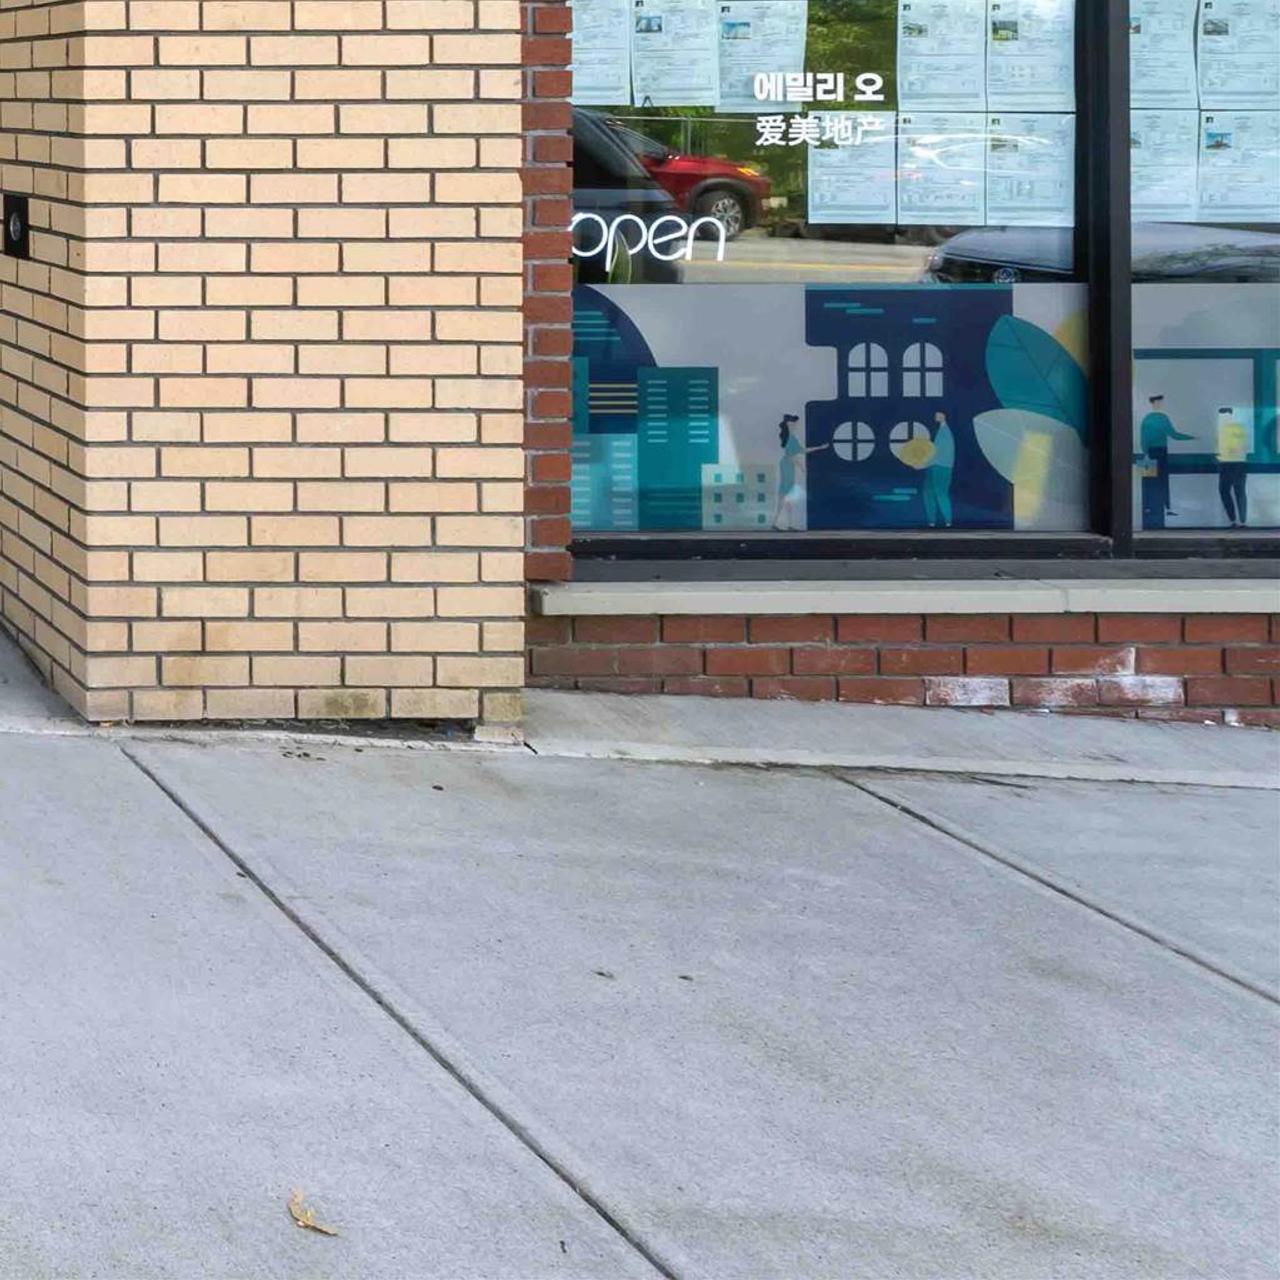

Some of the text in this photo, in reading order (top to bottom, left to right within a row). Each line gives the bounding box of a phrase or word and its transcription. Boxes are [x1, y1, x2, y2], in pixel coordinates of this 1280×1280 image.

[753, 72, 885, 102] 에밀리 오
[755, 115, 886, 147] 爱美地产
[569, 212, 727, 272] open
